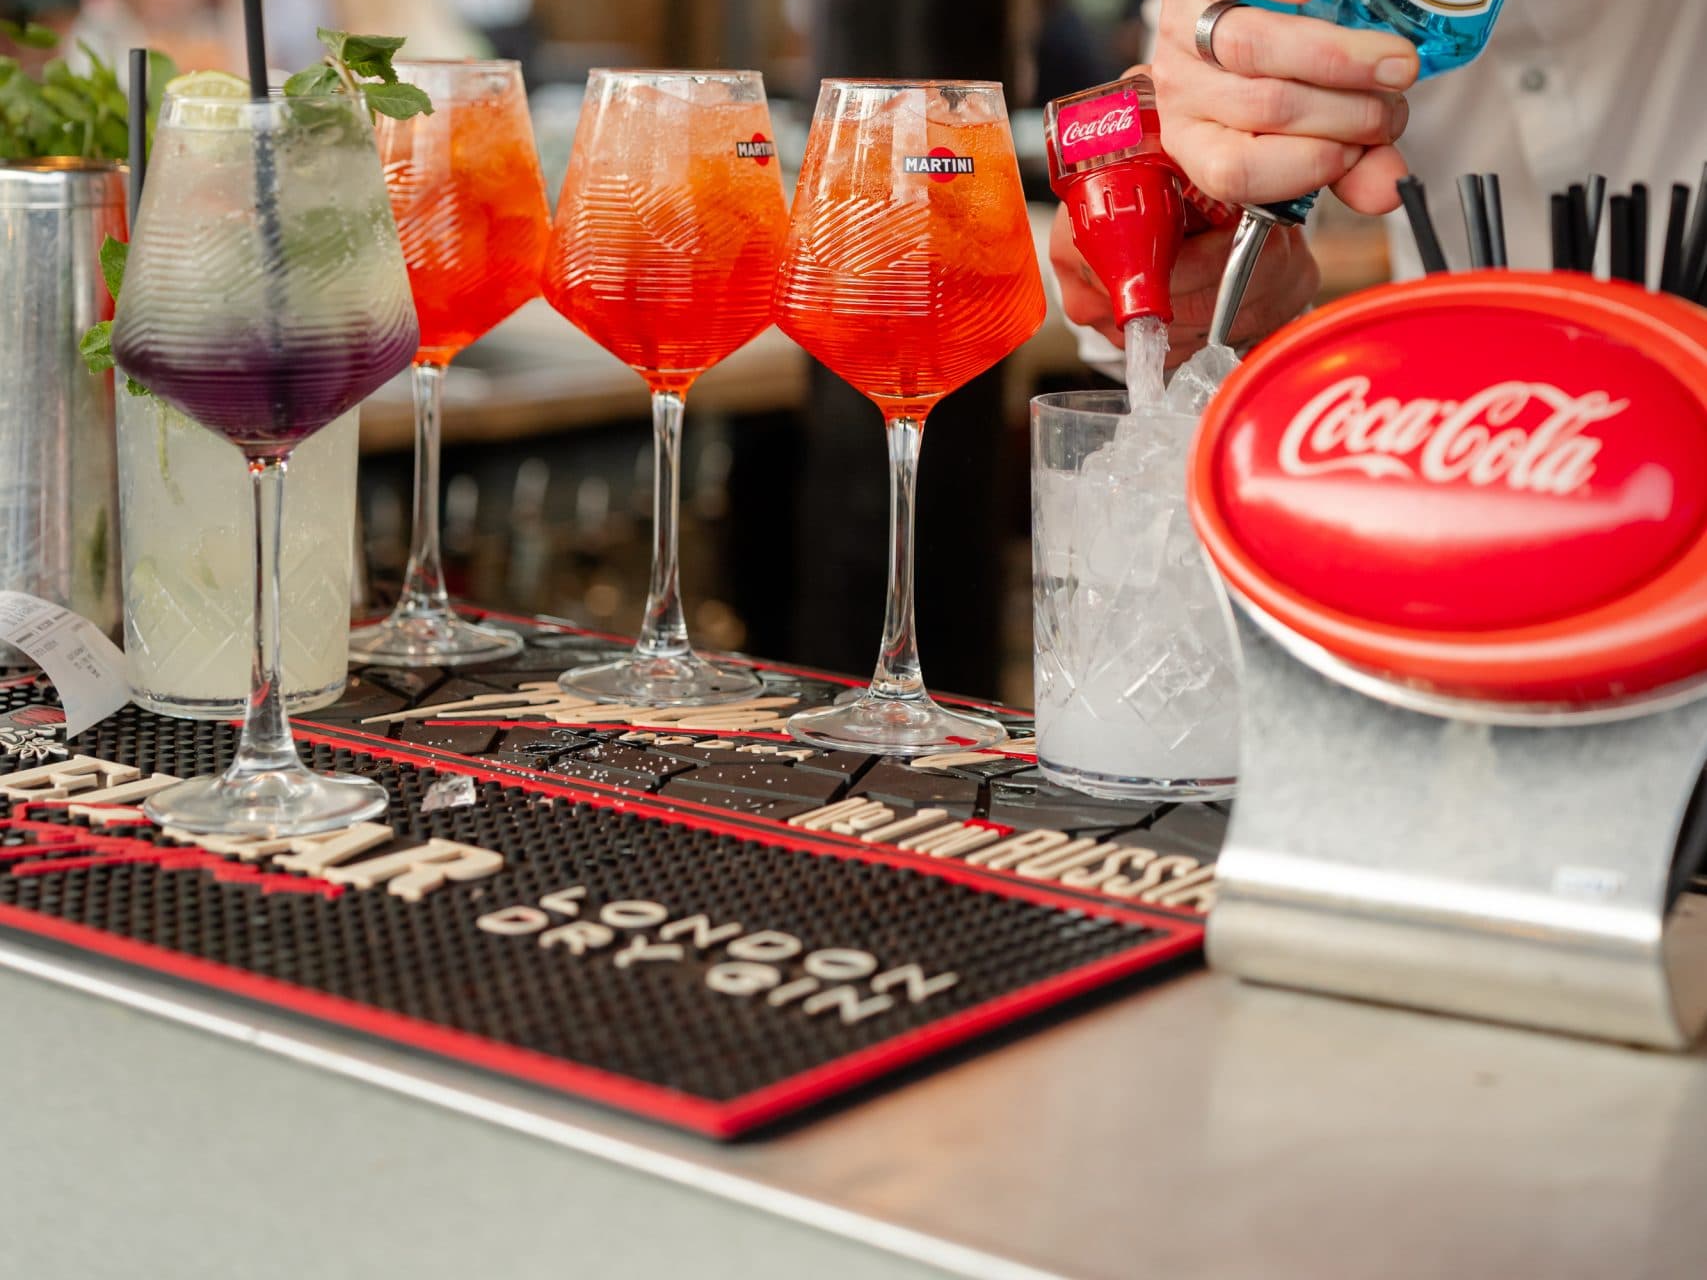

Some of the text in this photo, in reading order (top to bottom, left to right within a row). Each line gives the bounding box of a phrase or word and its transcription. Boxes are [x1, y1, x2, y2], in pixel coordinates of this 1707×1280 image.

[905, 157, 973, 173] MARTINI
[476, 905, 894, 1022] DRY GIN
[539, 886, 958, 1003] LONDON
